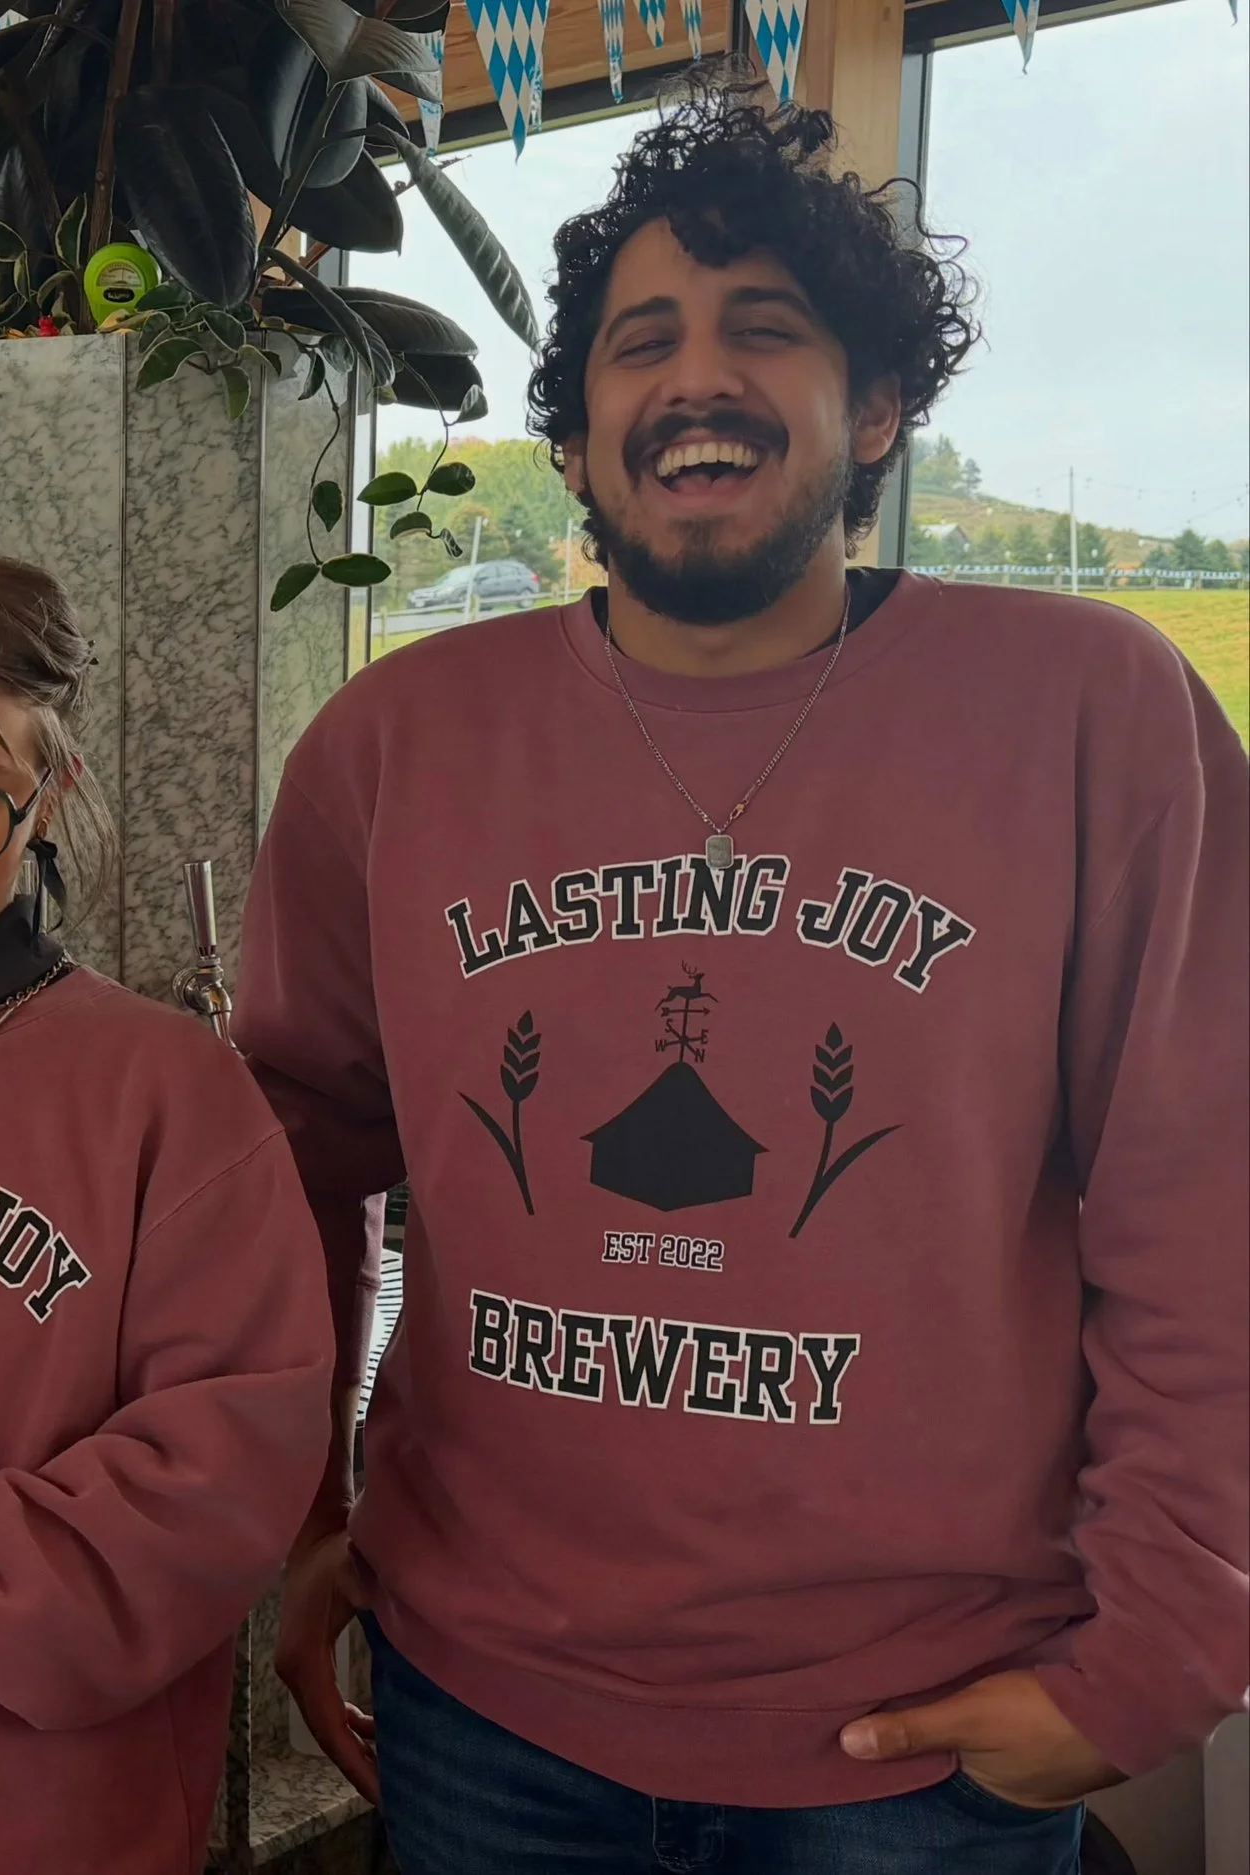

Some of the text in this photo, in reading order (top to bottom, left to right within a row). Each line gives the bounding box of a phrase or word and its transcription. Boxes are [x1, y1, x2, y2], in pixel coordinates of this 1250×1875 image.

[445, 854, 977, 994] LASTING JOY
[601, 1231, 725, 1272] EST 2022
[468, 1288, 860, 1425] BREWERY
